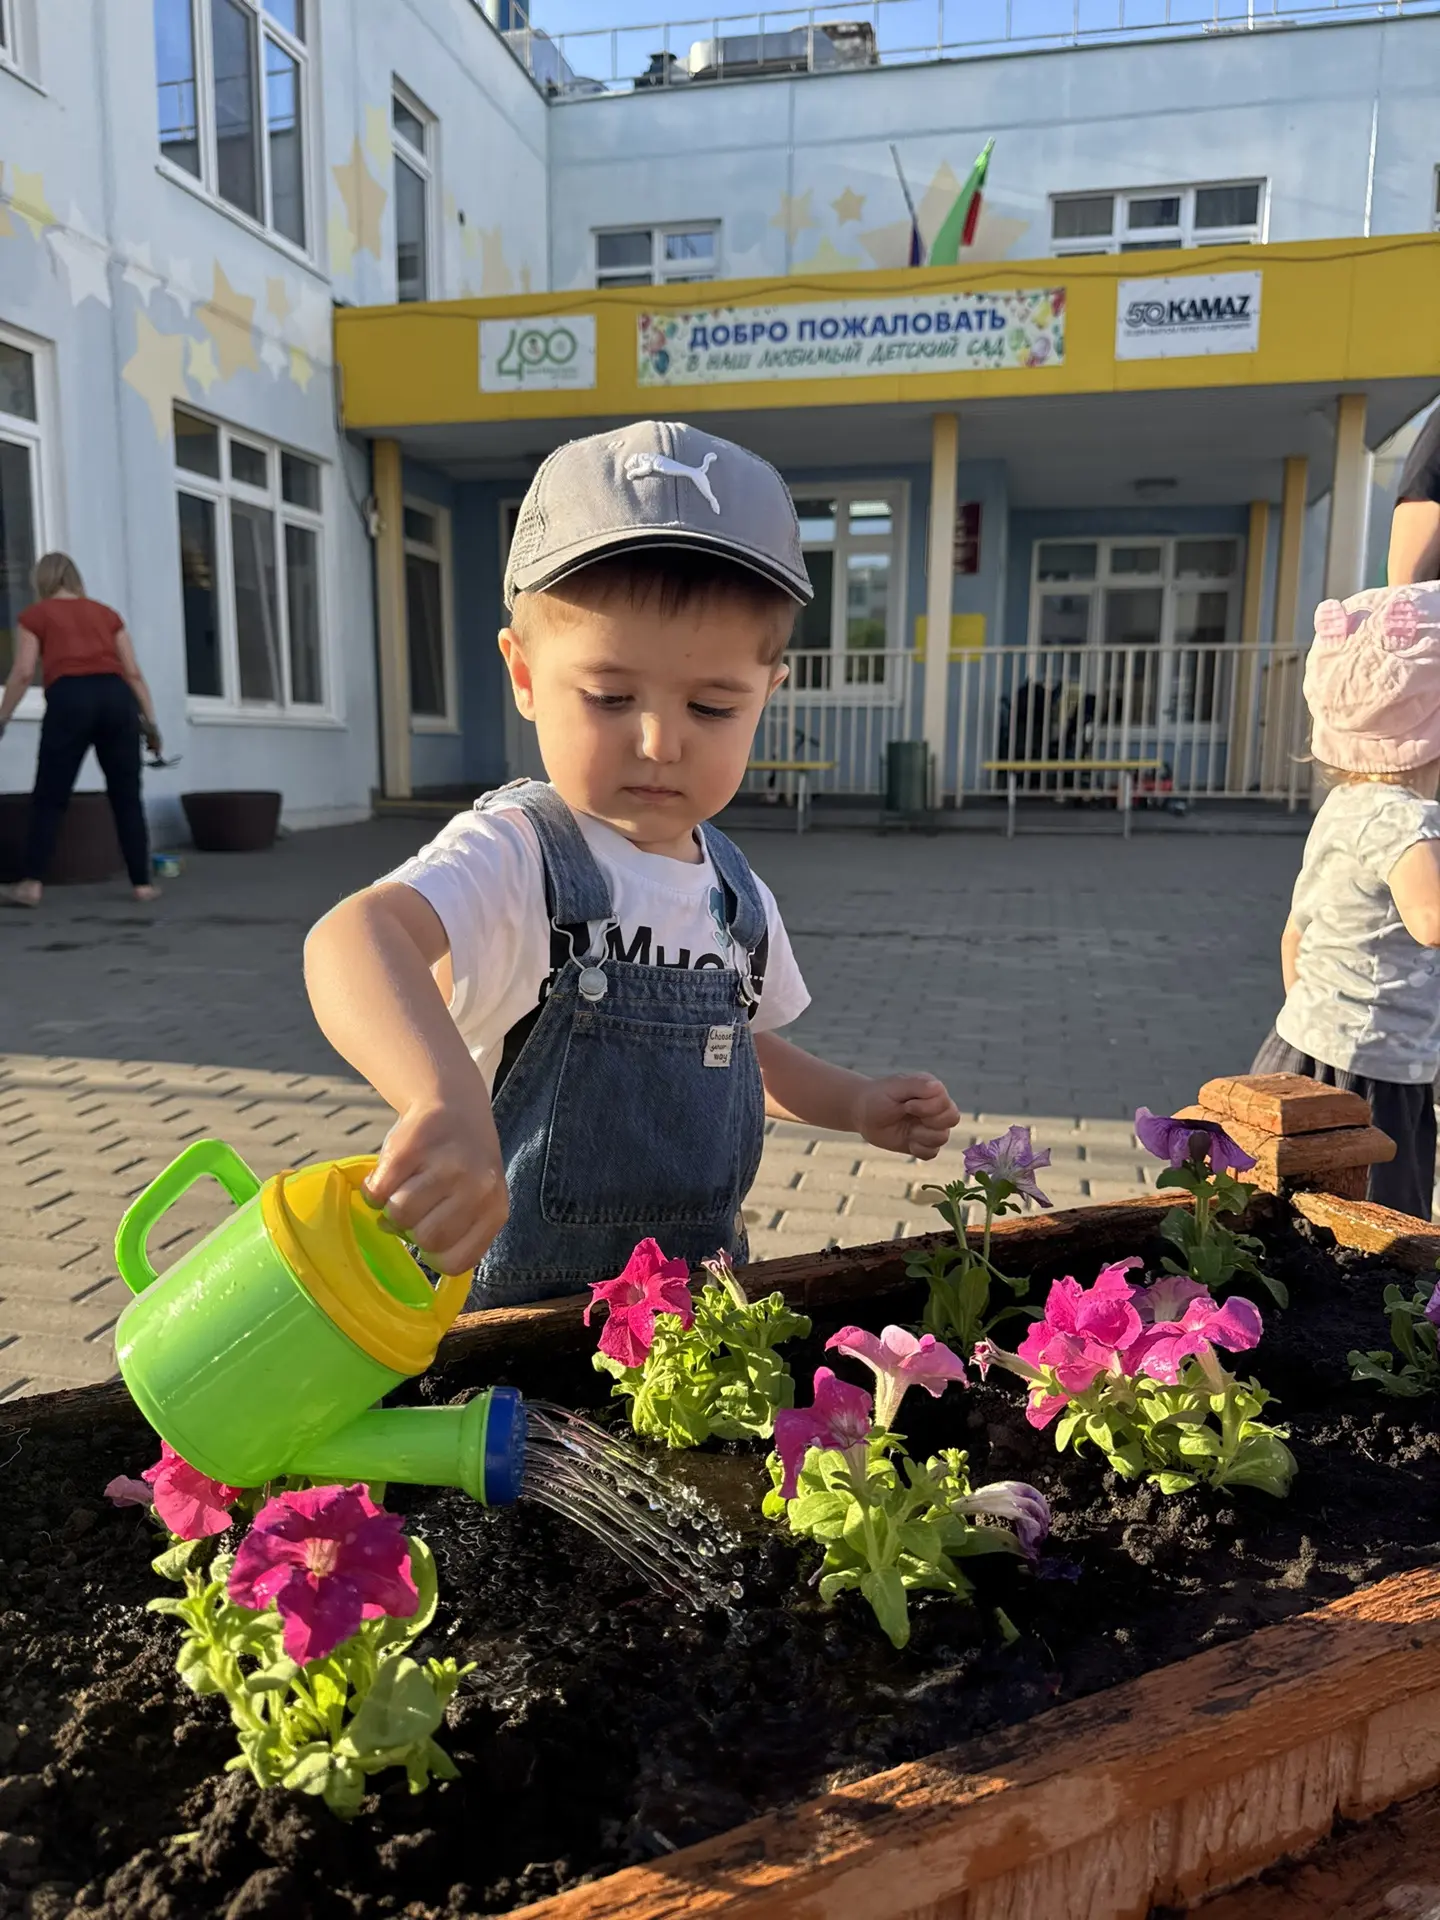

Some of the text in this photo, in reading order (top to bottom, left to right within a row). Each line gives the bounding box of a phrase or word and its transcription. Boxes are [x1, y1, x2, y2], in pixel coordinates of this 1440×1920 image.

[1168, 294, 1252, 322] KAMAZ
[689, 309, 1006, 350] ДОБРО ПОЖАЛОВАТЬ
[686, 336, 1006, 372] В НАШ ЛЮБИМЫЙ ДЕТСКИЙ САД
